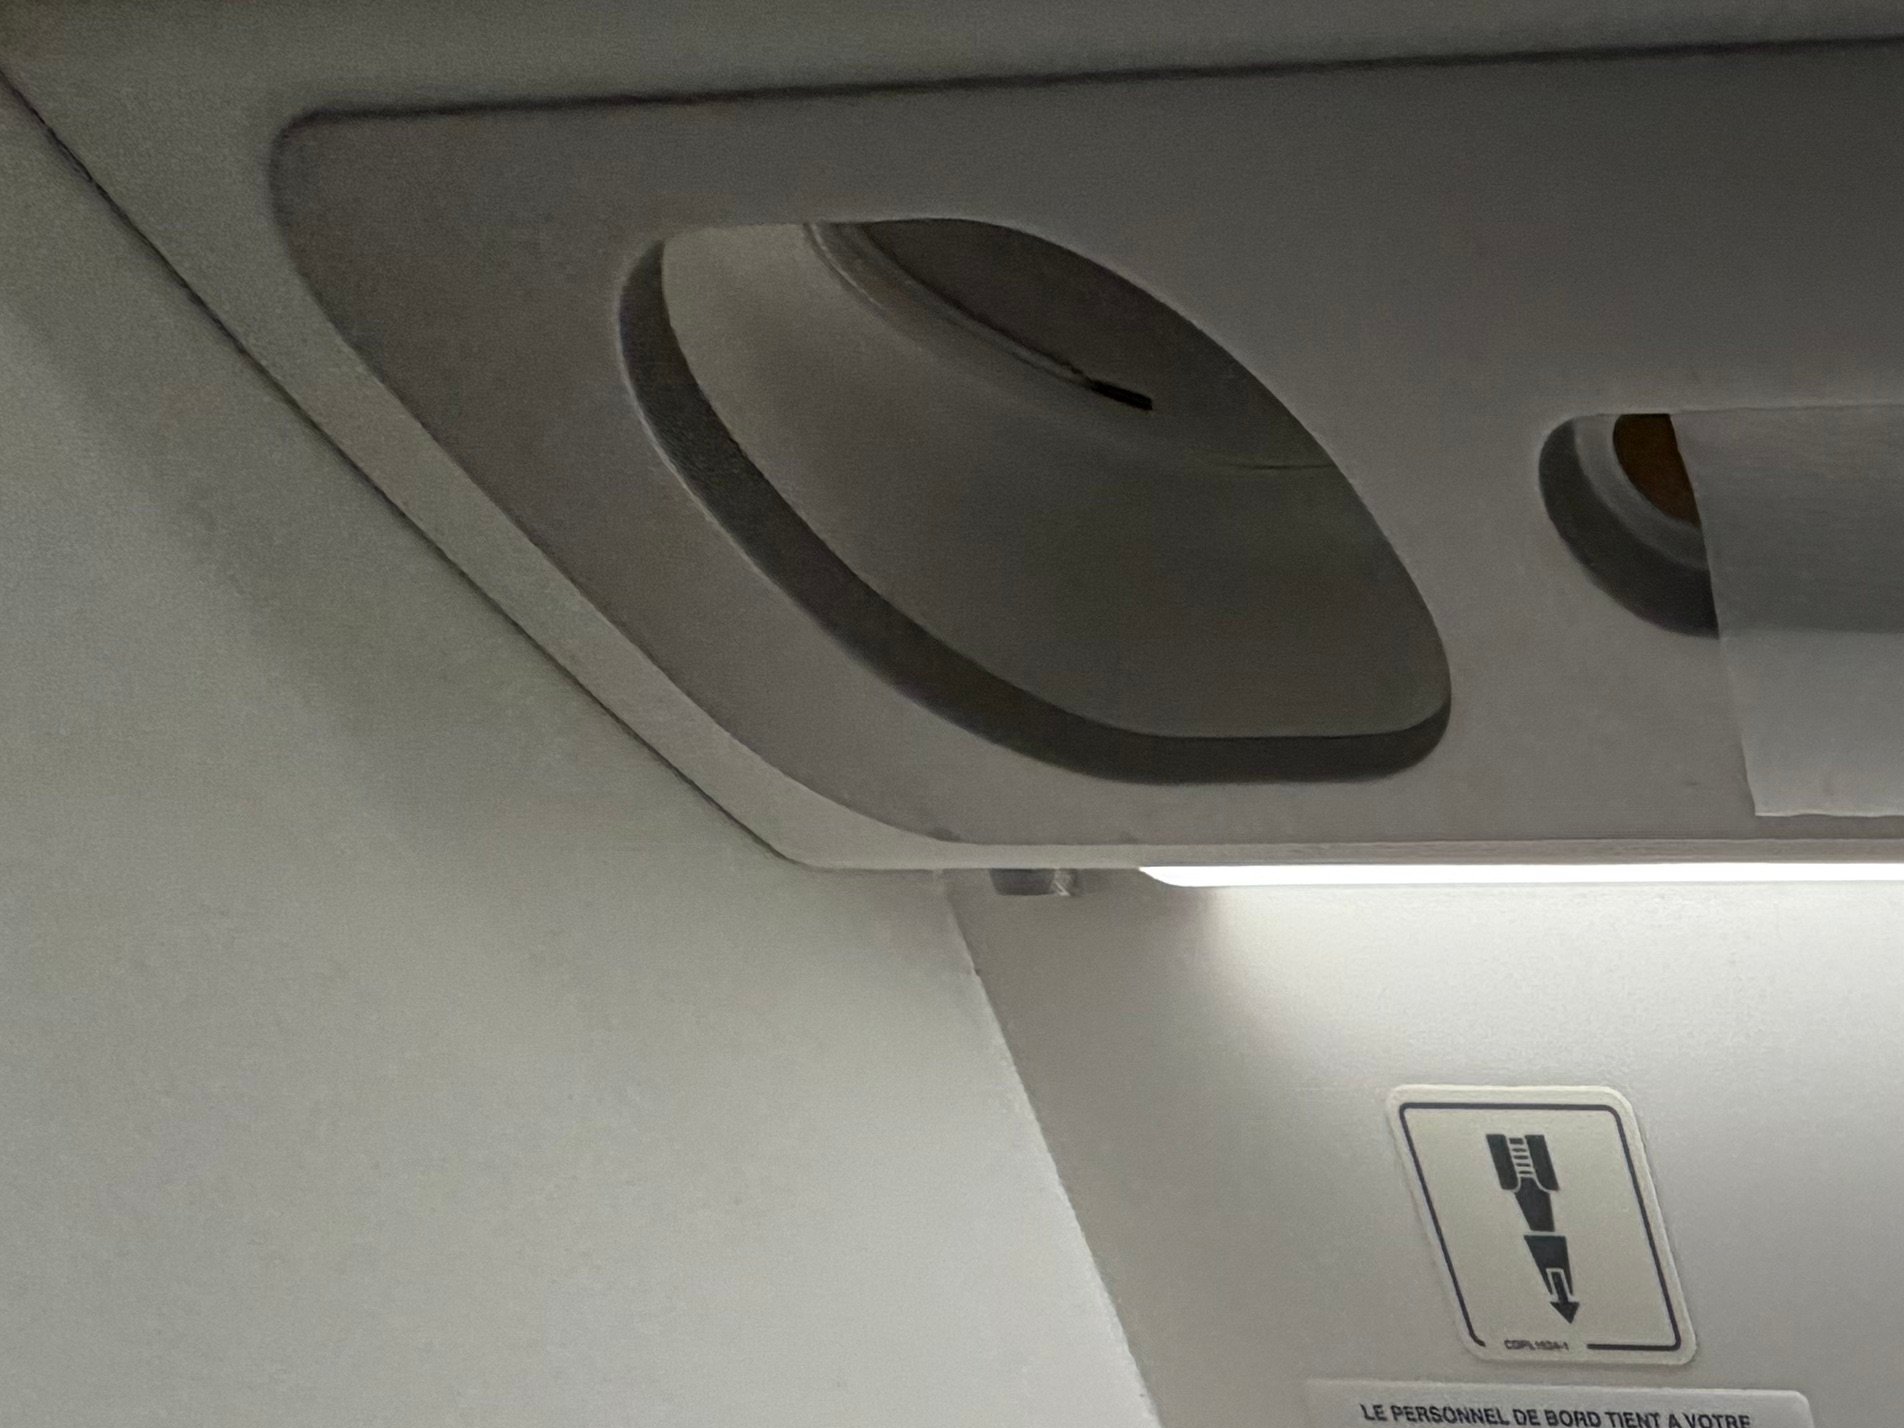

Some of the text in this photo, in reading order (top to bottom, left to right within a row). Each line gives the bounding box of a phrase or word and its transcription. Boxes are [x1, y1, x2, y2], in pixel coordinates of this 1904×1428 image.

[1361, 1404, 1387, 1421] LE
[1391, 1405, 1509, 1425] PERSONNEL
[1513, 1409, 1541, 1426] DE
[1544, 1409, 1601, 1428] BORD
